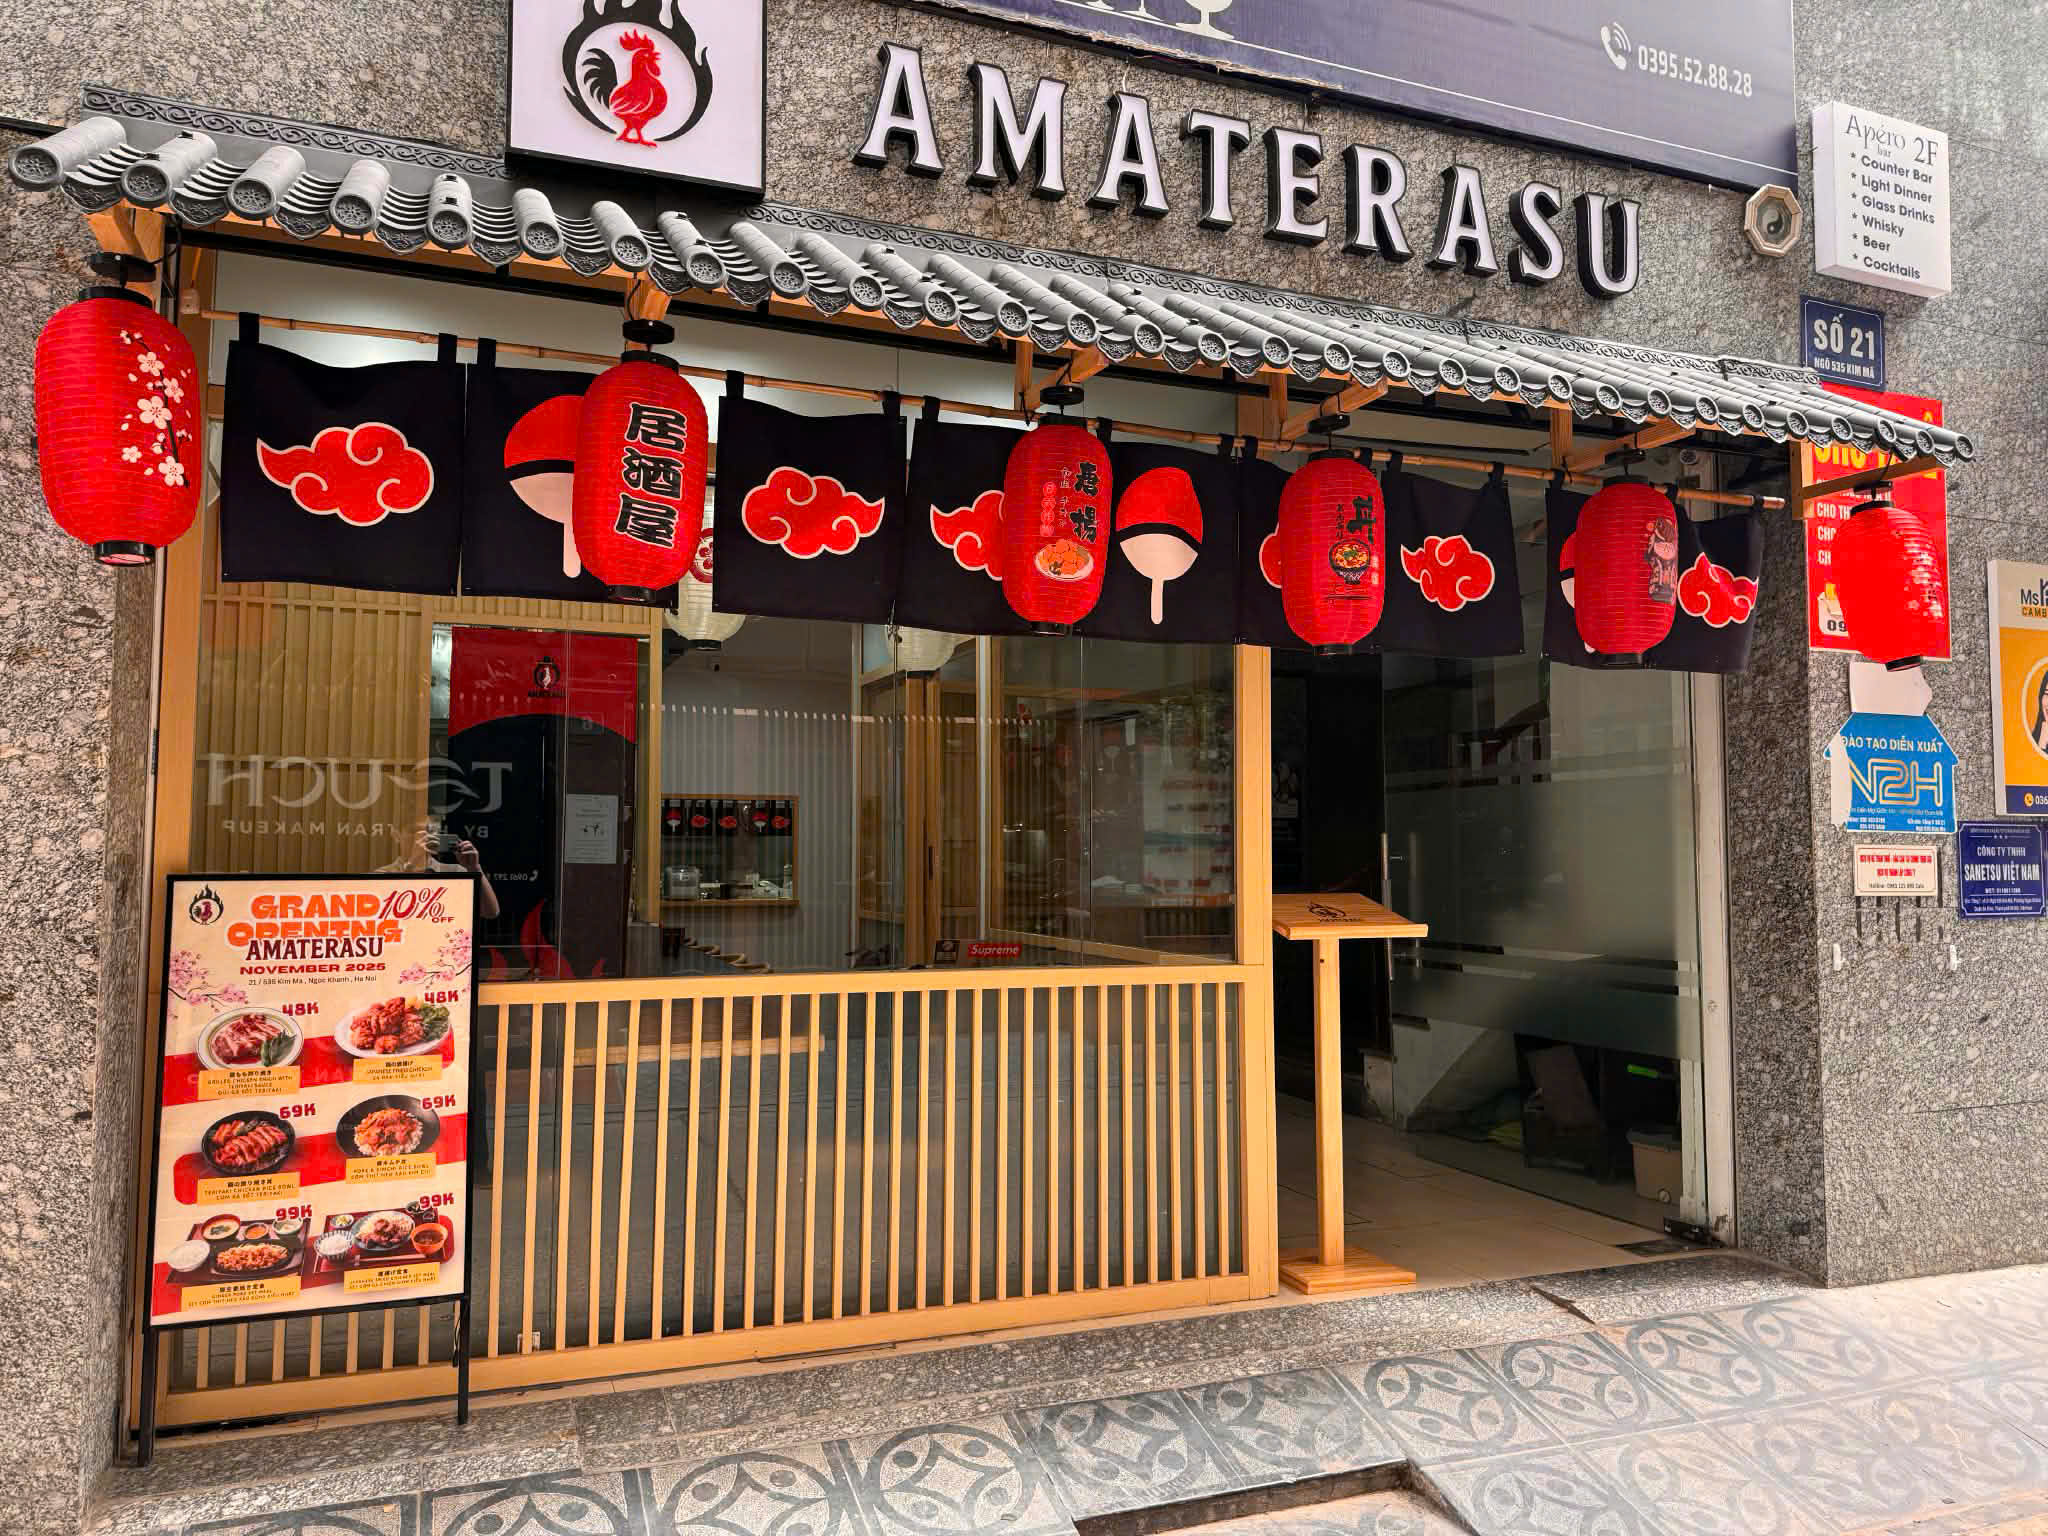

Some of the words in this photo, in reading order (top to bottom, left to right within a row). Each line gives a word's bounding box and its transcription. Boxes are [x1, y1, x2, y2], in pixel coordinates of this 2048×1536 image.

[1638, 45, 1752, 97] 0395.52.88.28
[1846, 114, 1906, 150] Apéro
[1913, 136, 1939, 166] 2F
[1877, 144, 1892, 158] bar
[853, 41, 1641, 298] AMATERASU
[1861, 155, 1911, 176] Counter
[1913, 169, 1933, 184] Bar
[1861, 174, 1891, 193] Light
[1894, 184, 1932, 204] Dinner
[1862, 196, 1896, 214] Glass
[1899, 204, 1936, 224] Drinks
[1862, 214, 1905, 238] Whisky
[1863, 235, 1891, 252] Beer
[1863, 256, 1921, 279] Cocktails
[1813, 314, 1844, 354] SỐ
[1850, 327, 1875, 361] 21
[1831, 359, 1846, 373] 535
[1847, 363, 1861, 376] KIM
[613, 402, 688, 549] 居酒屋
[1816, 502, 1836, 518] CHO
[1838, 505, 1851, 520] TH
[1818, 549, 1832, 566] CH
[1865, 737, 1888, 751] TẠO
[1917, 737, 1943, 753] XUẤT
[1964, 864, 2001, 880] SANETSU
[2002, 860, 2019, 884] VIỆT
[2021, 864, 2040, 880] NAM
[250, 893, 381, 919] GRAND
[379, 886, 448, 921] 10%
[227, 919, 402, 948] OPENING
[245, 936, 385, 962] AMATERASU
[971, 945, 1018, 956] Supreme
[239, 964, 340, 975] NOVEMBER
[344, 962, 386, 972] 2025
[424, 990, 459, 1004] 48K
[282, 1002, 319, 1017] 48K
[279, 1103, 317, 1120] 69K
[420, 1095, 456, 1110] 69K
[419, 1192, 455, 1208] 99K
[275, 1205, 313, 1220] 99K
